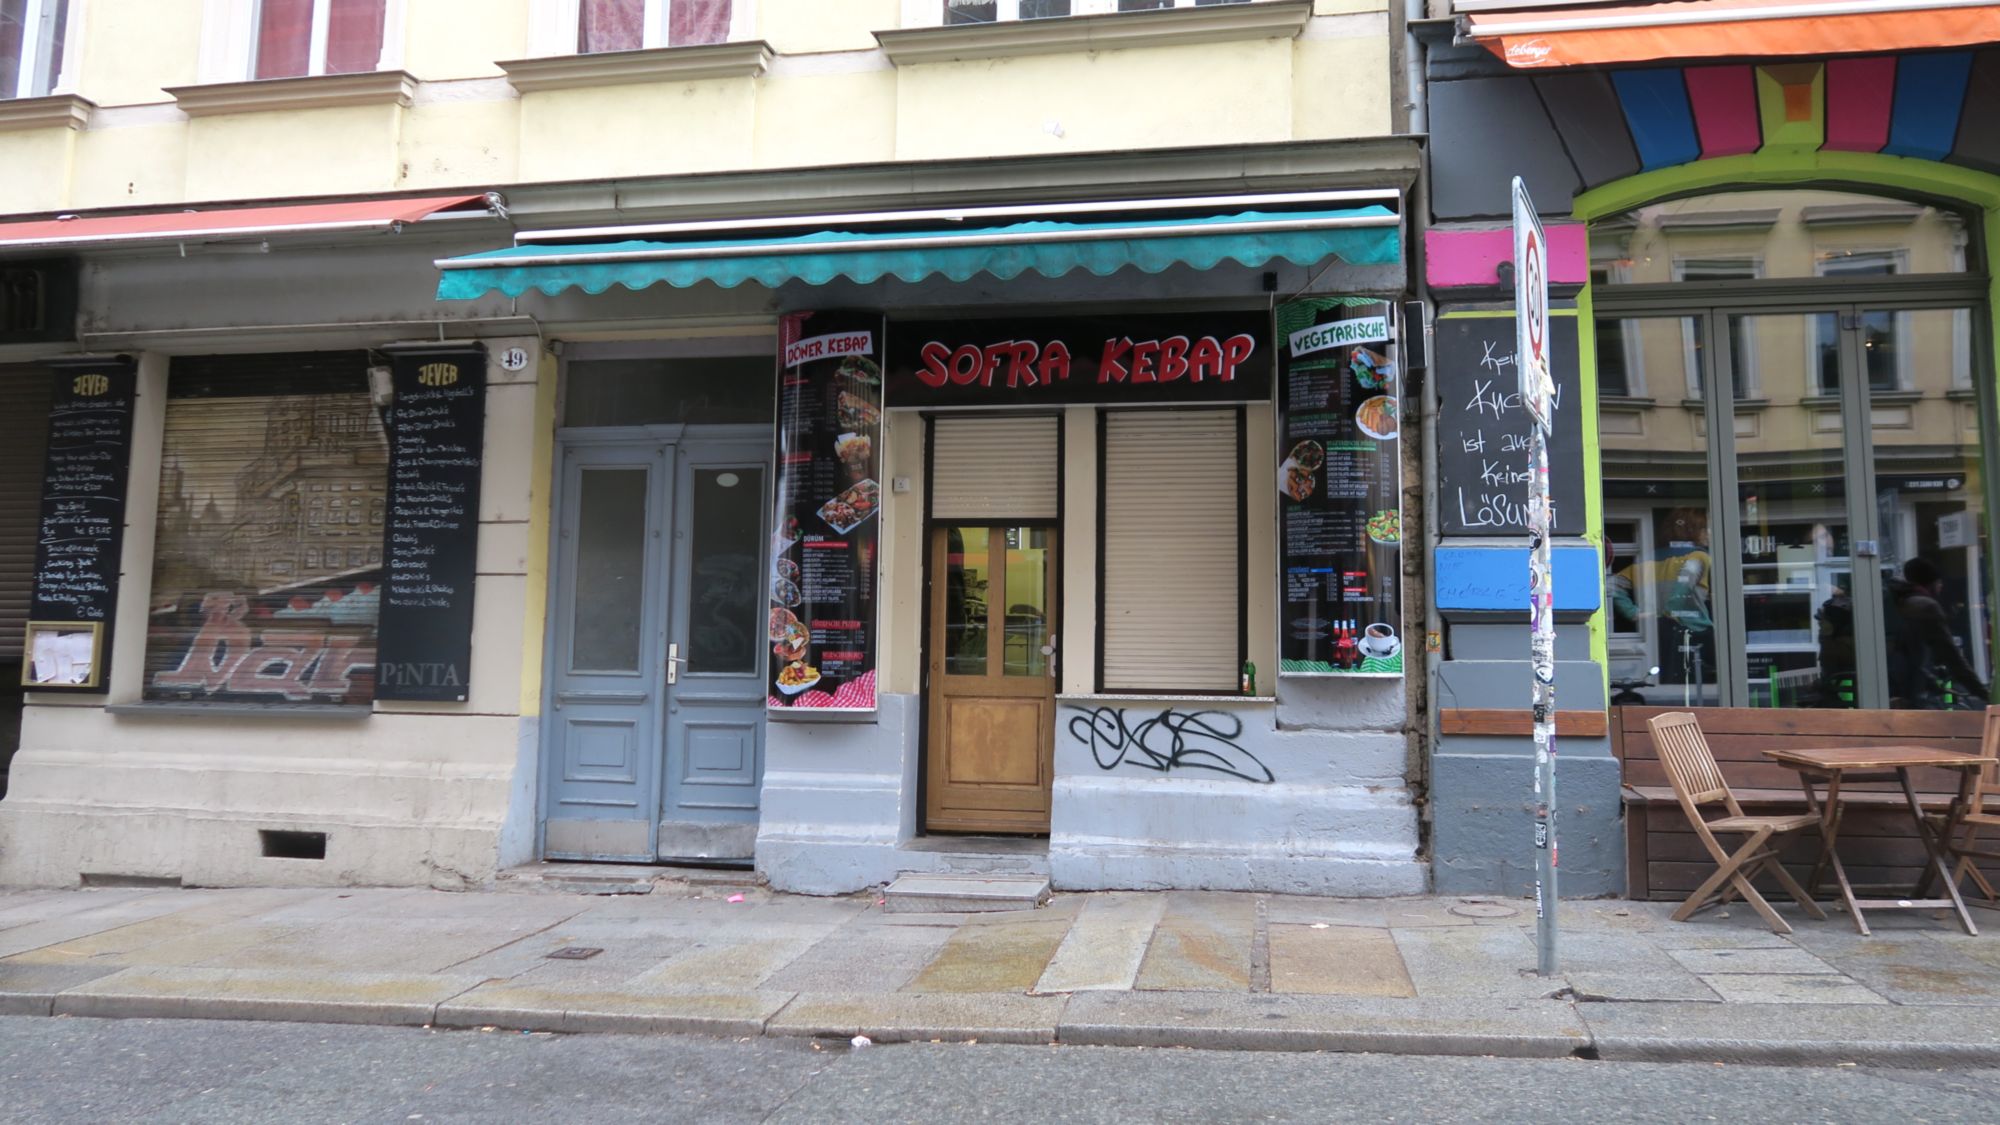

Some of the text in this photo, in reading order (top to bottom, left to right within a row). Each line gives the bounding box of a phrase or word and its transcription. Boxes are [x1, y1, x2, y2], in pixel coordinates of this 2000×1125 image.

[505, 351, 523, 367] 49
[787, 335, 869, 364] DÖNER KEBAP
[915, 333, 1256, 388] SOFRA KEBAP
[73, 374, 109, 396] JEVER
[418, 362, 459, 386] JEVER
[1460, 429, 1530, 453] ist auc
